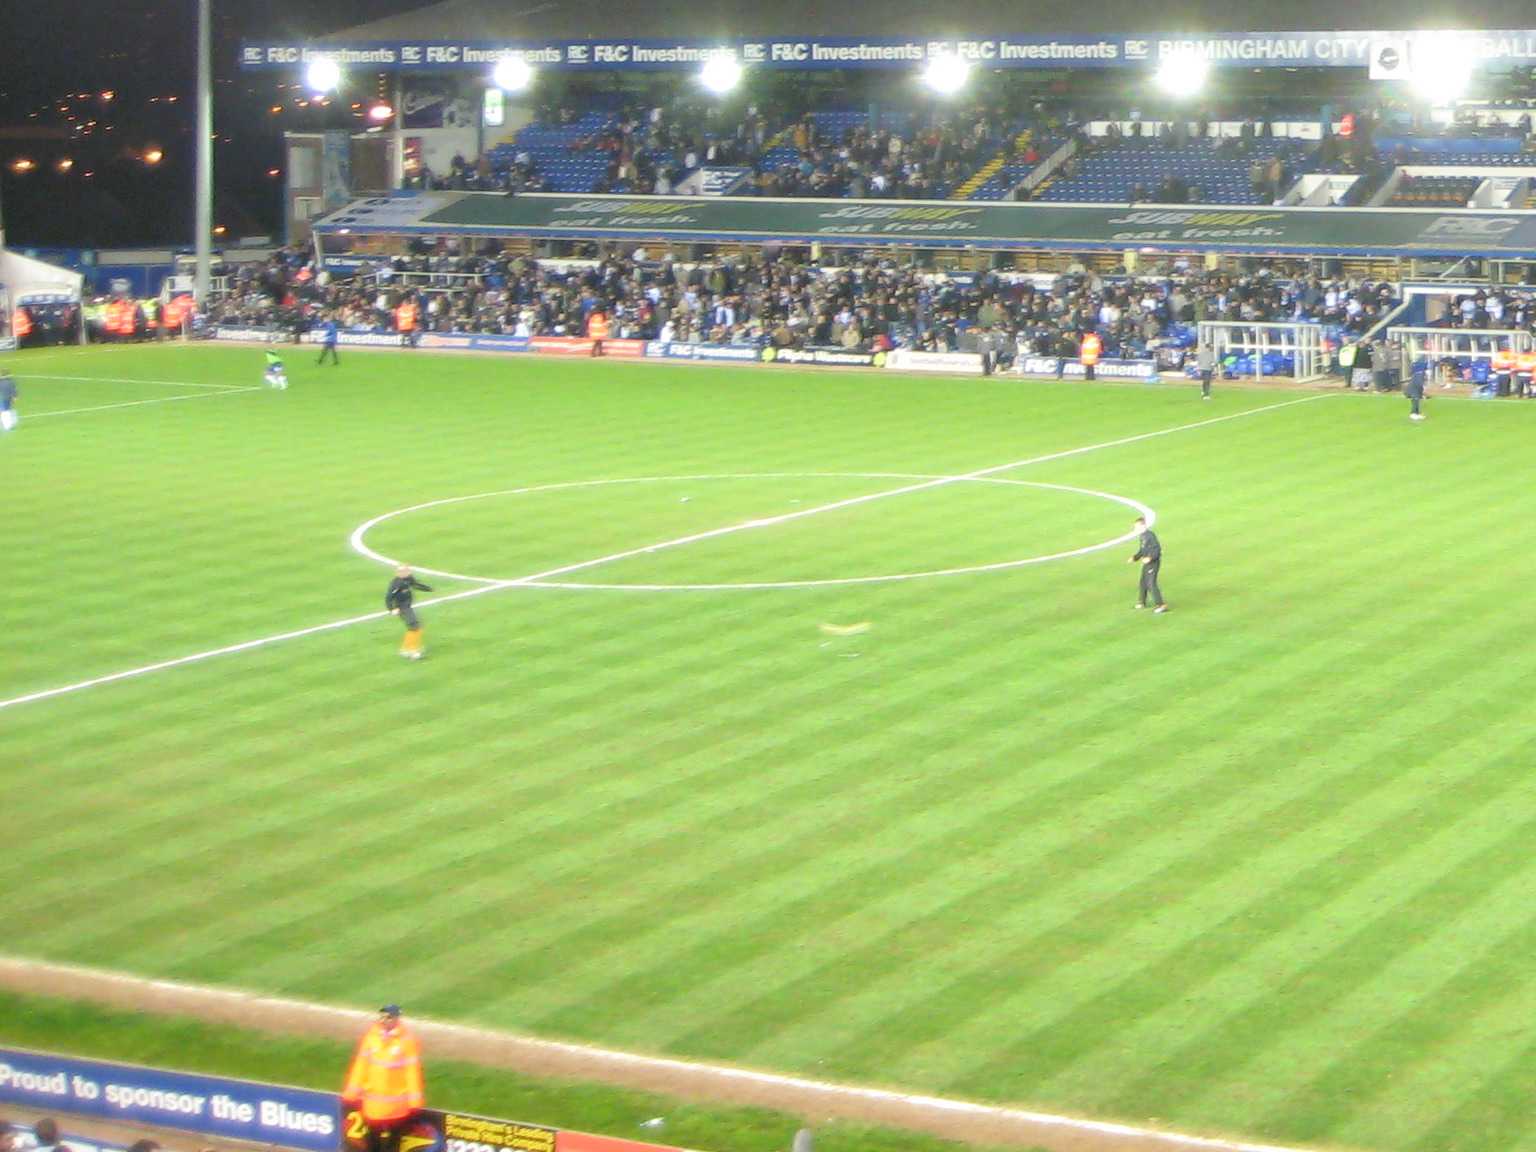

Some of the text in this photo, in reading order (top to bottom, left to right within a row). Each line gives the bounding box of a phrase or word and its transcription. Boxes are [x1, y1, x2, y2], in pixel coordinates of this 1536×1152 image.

[267, 46, 298, 64] F&C
[301, 46, 395, 64] Investments
[426, 45, 460, 63] F&C
[462, 45, 562, 63] Investments
[594, 44, 629, 62] F&C
[631, 44, 737, 62] Investments
[771, 43, 808, 61] F&C
[811, 43, 922, 61] Investments
[957, 41, 996, 60] F&C
[999, 41, 1118, 60] Investments
[1158, 38, 1308, 60] BIRMINGHAM
[1314, 36, 1370, 59] CITY
[552, 201, 708, 215] SUBWAY
[818, 205, 985, 220] SUBWAY
[1106, 211, 1286, 226] SUBWAY
[311, 331, 329, 343] F&
[669, 344, 692, 356] F&C
[693, 345, 757, 359] Investments
[1025, 358, 1057, 373] F&C
[0, 1062, 335, 1135] Proud to sponsor the Blues
